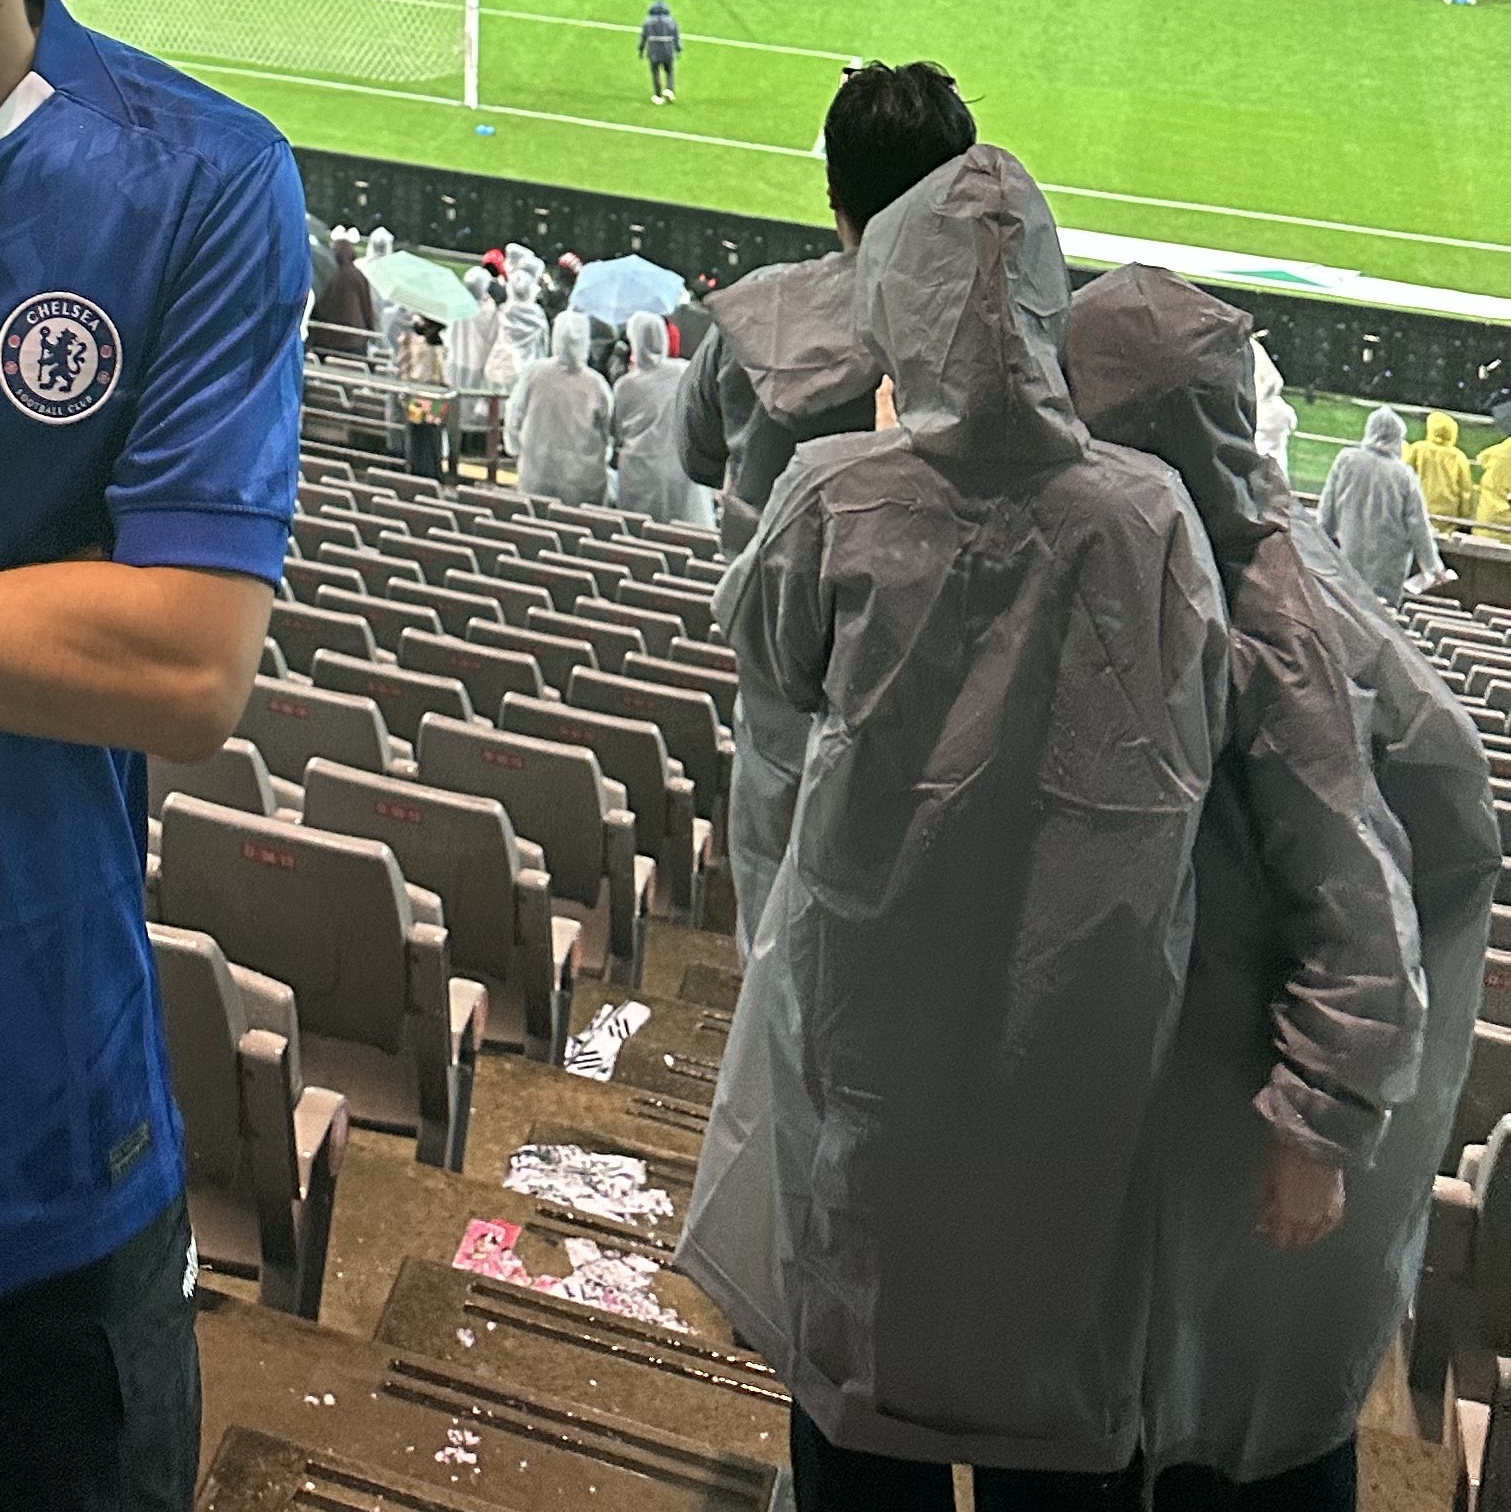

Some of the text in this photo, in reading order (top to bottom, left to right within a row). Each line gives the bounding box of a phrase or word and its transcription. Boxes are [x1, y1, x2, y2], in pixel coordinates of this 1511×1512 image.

[26, 301, 101, 332] CHELSEA
[15, 388, 94, 416] FOOTBALL CLUB
